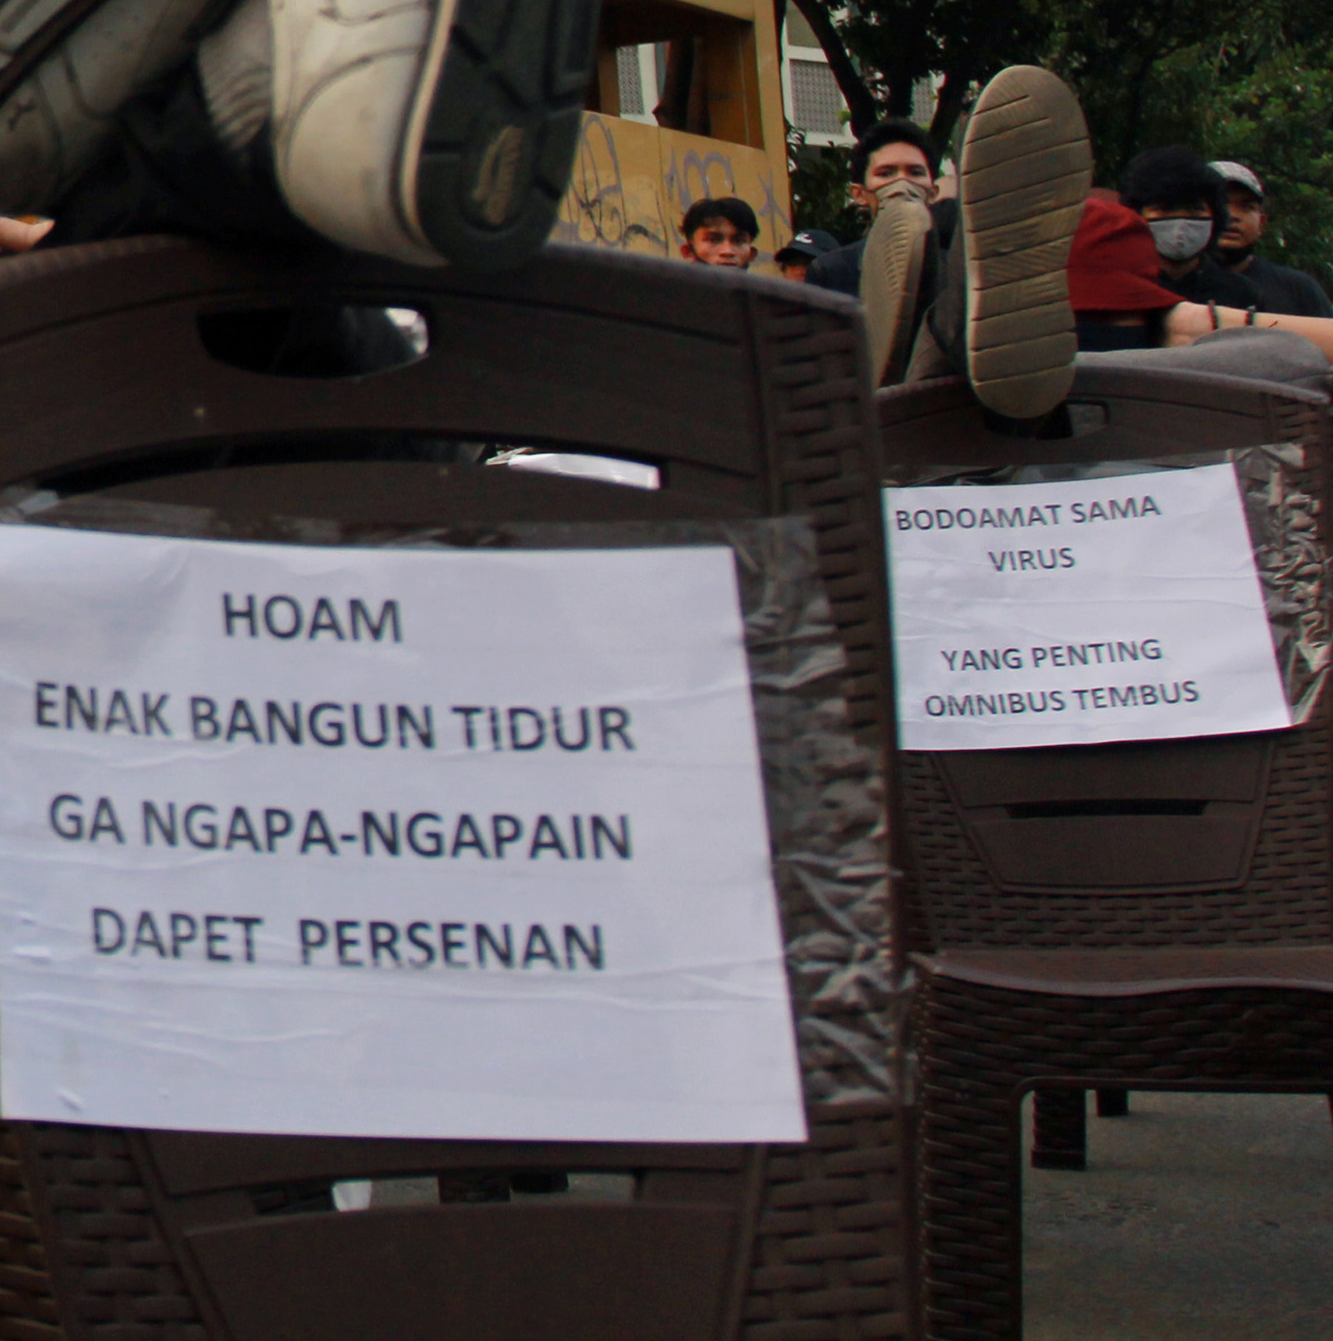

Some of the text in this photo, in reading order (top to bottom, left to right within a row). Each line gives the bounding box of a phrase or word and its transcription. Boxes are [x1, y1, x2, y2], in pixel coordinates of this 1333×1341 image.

[895, 495, 1162, 531] BODOAMAT SAMA
[988, 546, 1076, 573] VIRUS
[221, 592, 403, 643] HOAM
[940, 638, 1163, 671] YANG PENTING
[34, 681, 636, 752] ENAK BANGUN TIDUR
[925, 680, 1200, 717] OMNIBUS TEMBUS
[48, 793, 633, 861] GA NGAPA-NGAPAIN
[90, 907, 605, 971] DAPET PERSENAN
